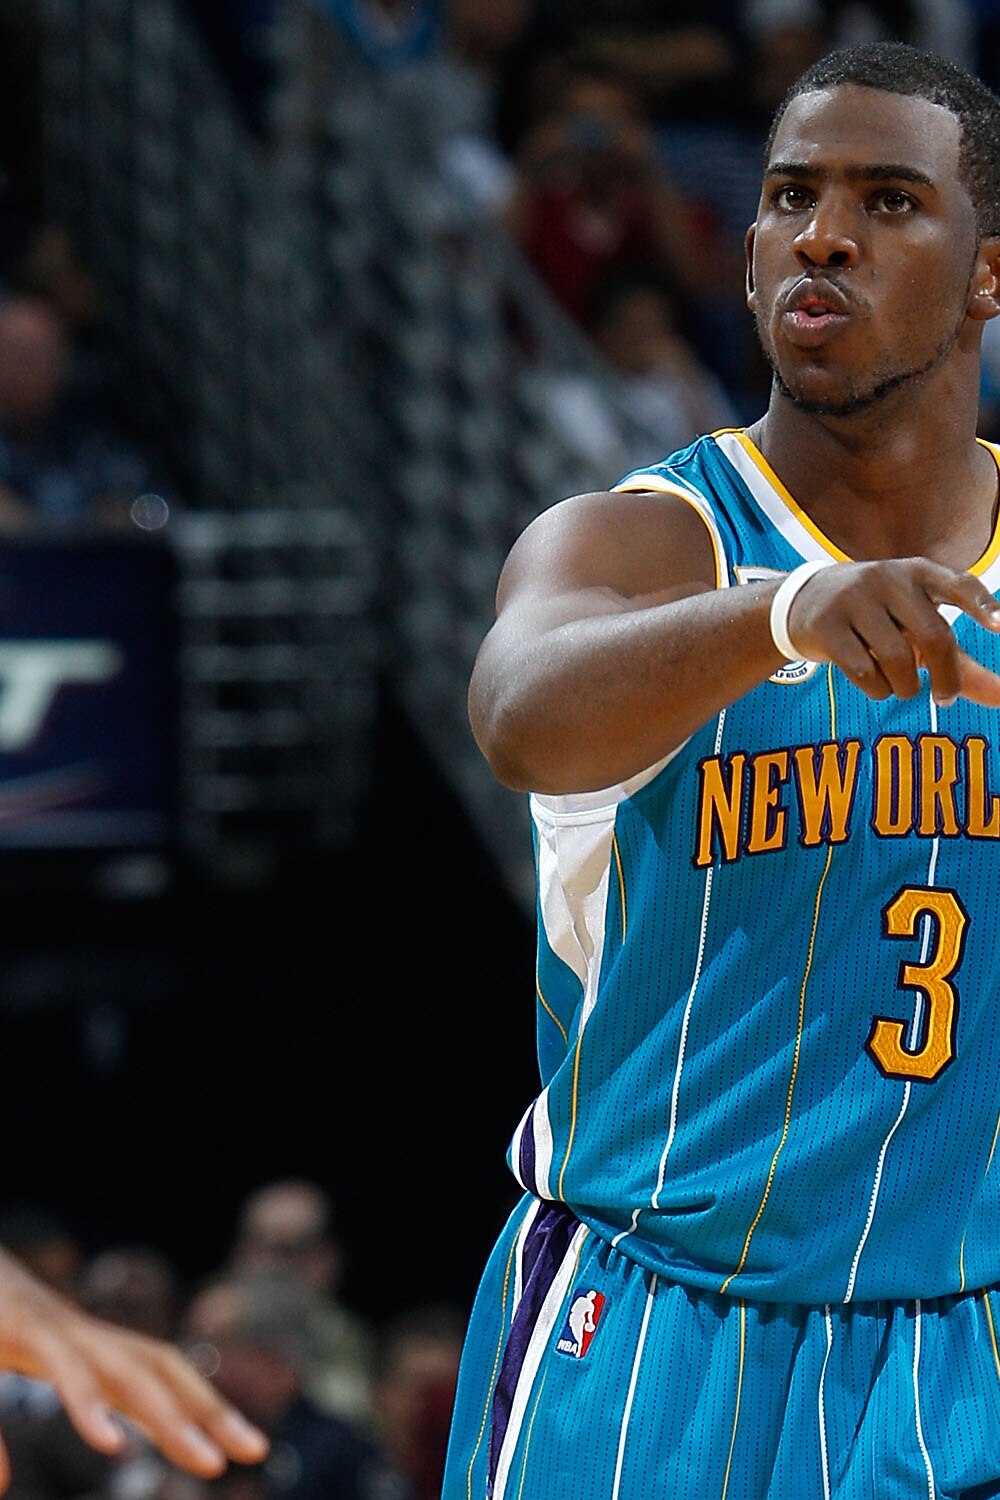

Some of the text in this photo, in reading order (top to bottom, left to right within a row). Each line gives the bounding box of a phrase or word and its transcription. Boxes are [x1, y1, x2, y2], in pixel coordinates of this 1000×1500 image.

[693, 740, 863, 869] NEW
[864, 884, 971, 1083] 3
[556, 1339, 578, 1355] NBA
